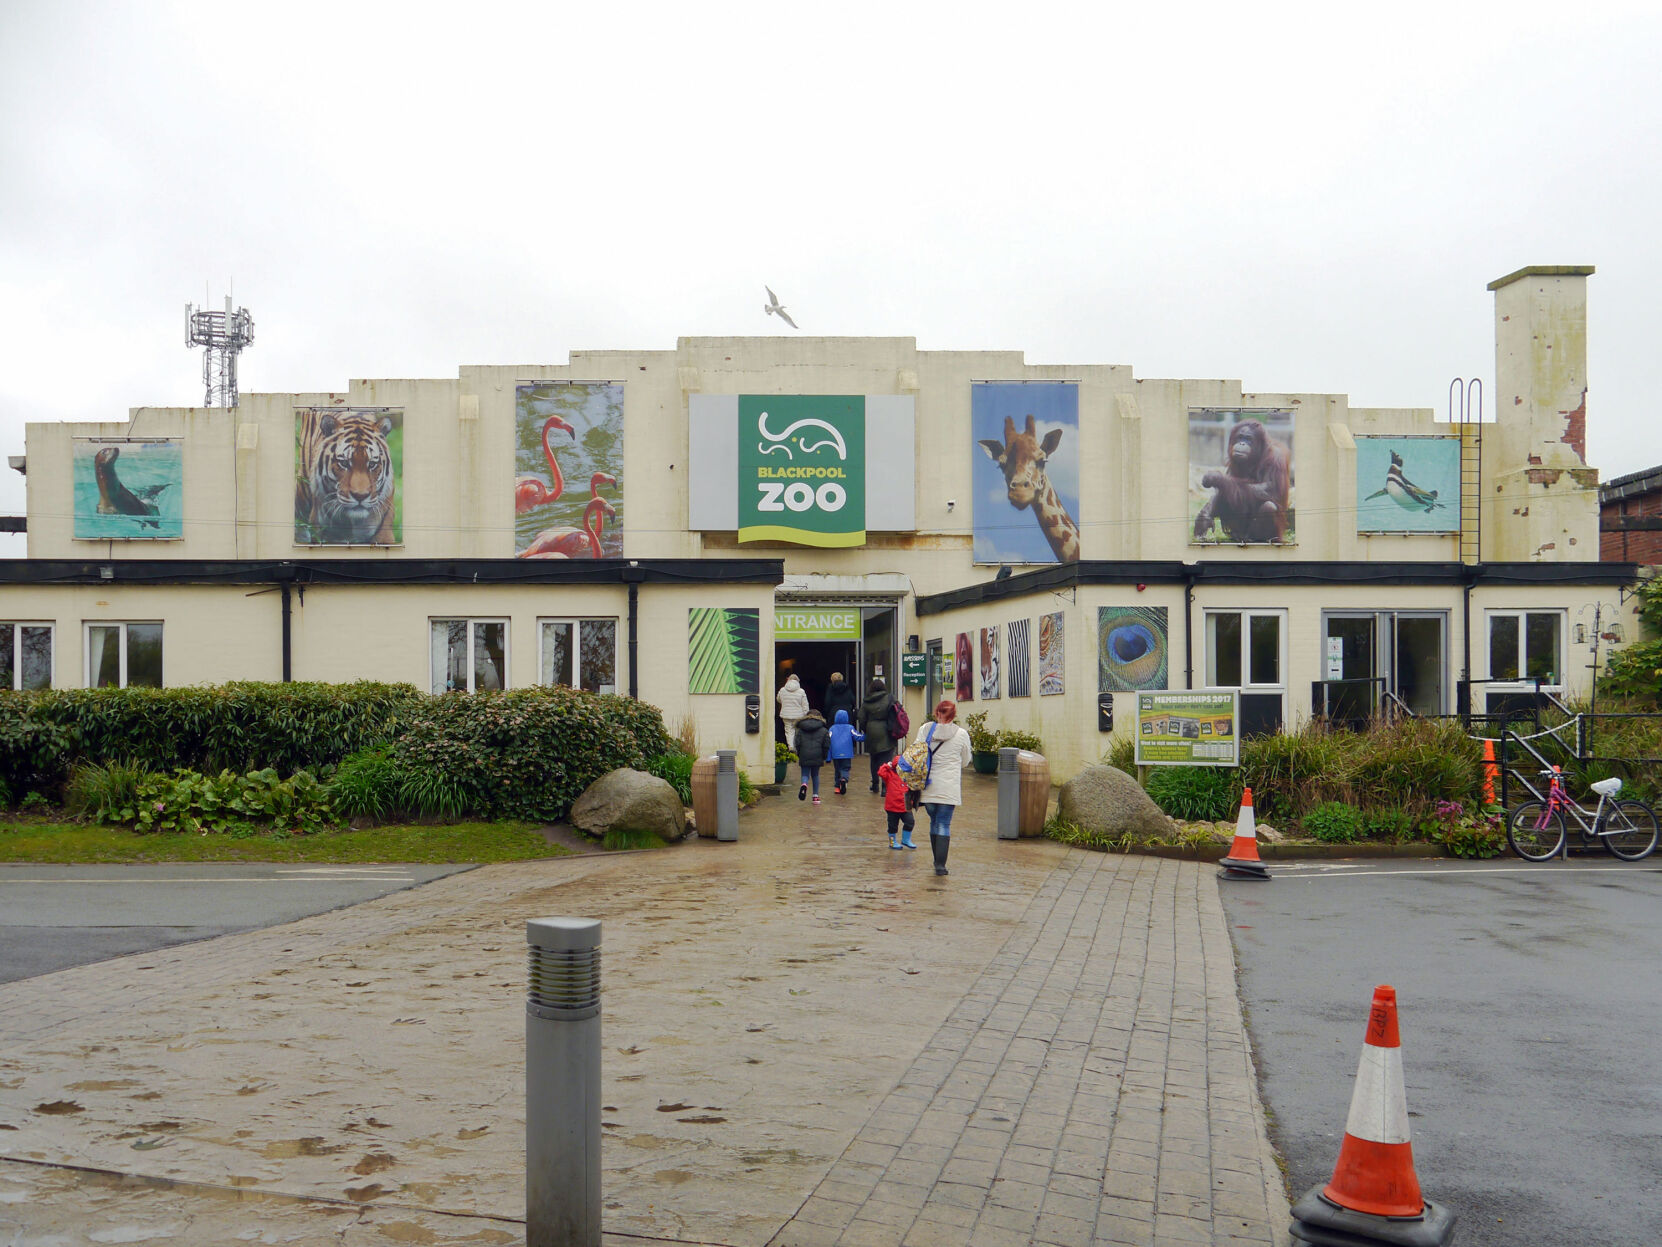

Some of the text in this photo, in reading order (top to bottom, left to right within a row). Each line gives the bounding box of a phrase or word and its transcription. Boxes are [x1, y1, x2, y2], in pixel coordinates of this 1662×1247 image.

[758, 467, 846, 478] BLACKPOOL
[757, 482, 847, 512] ZOO
[775, 614, 855, 629] NTRANCE
[1154, 695, 1231, 704] MEMBERSHIPS 2017
